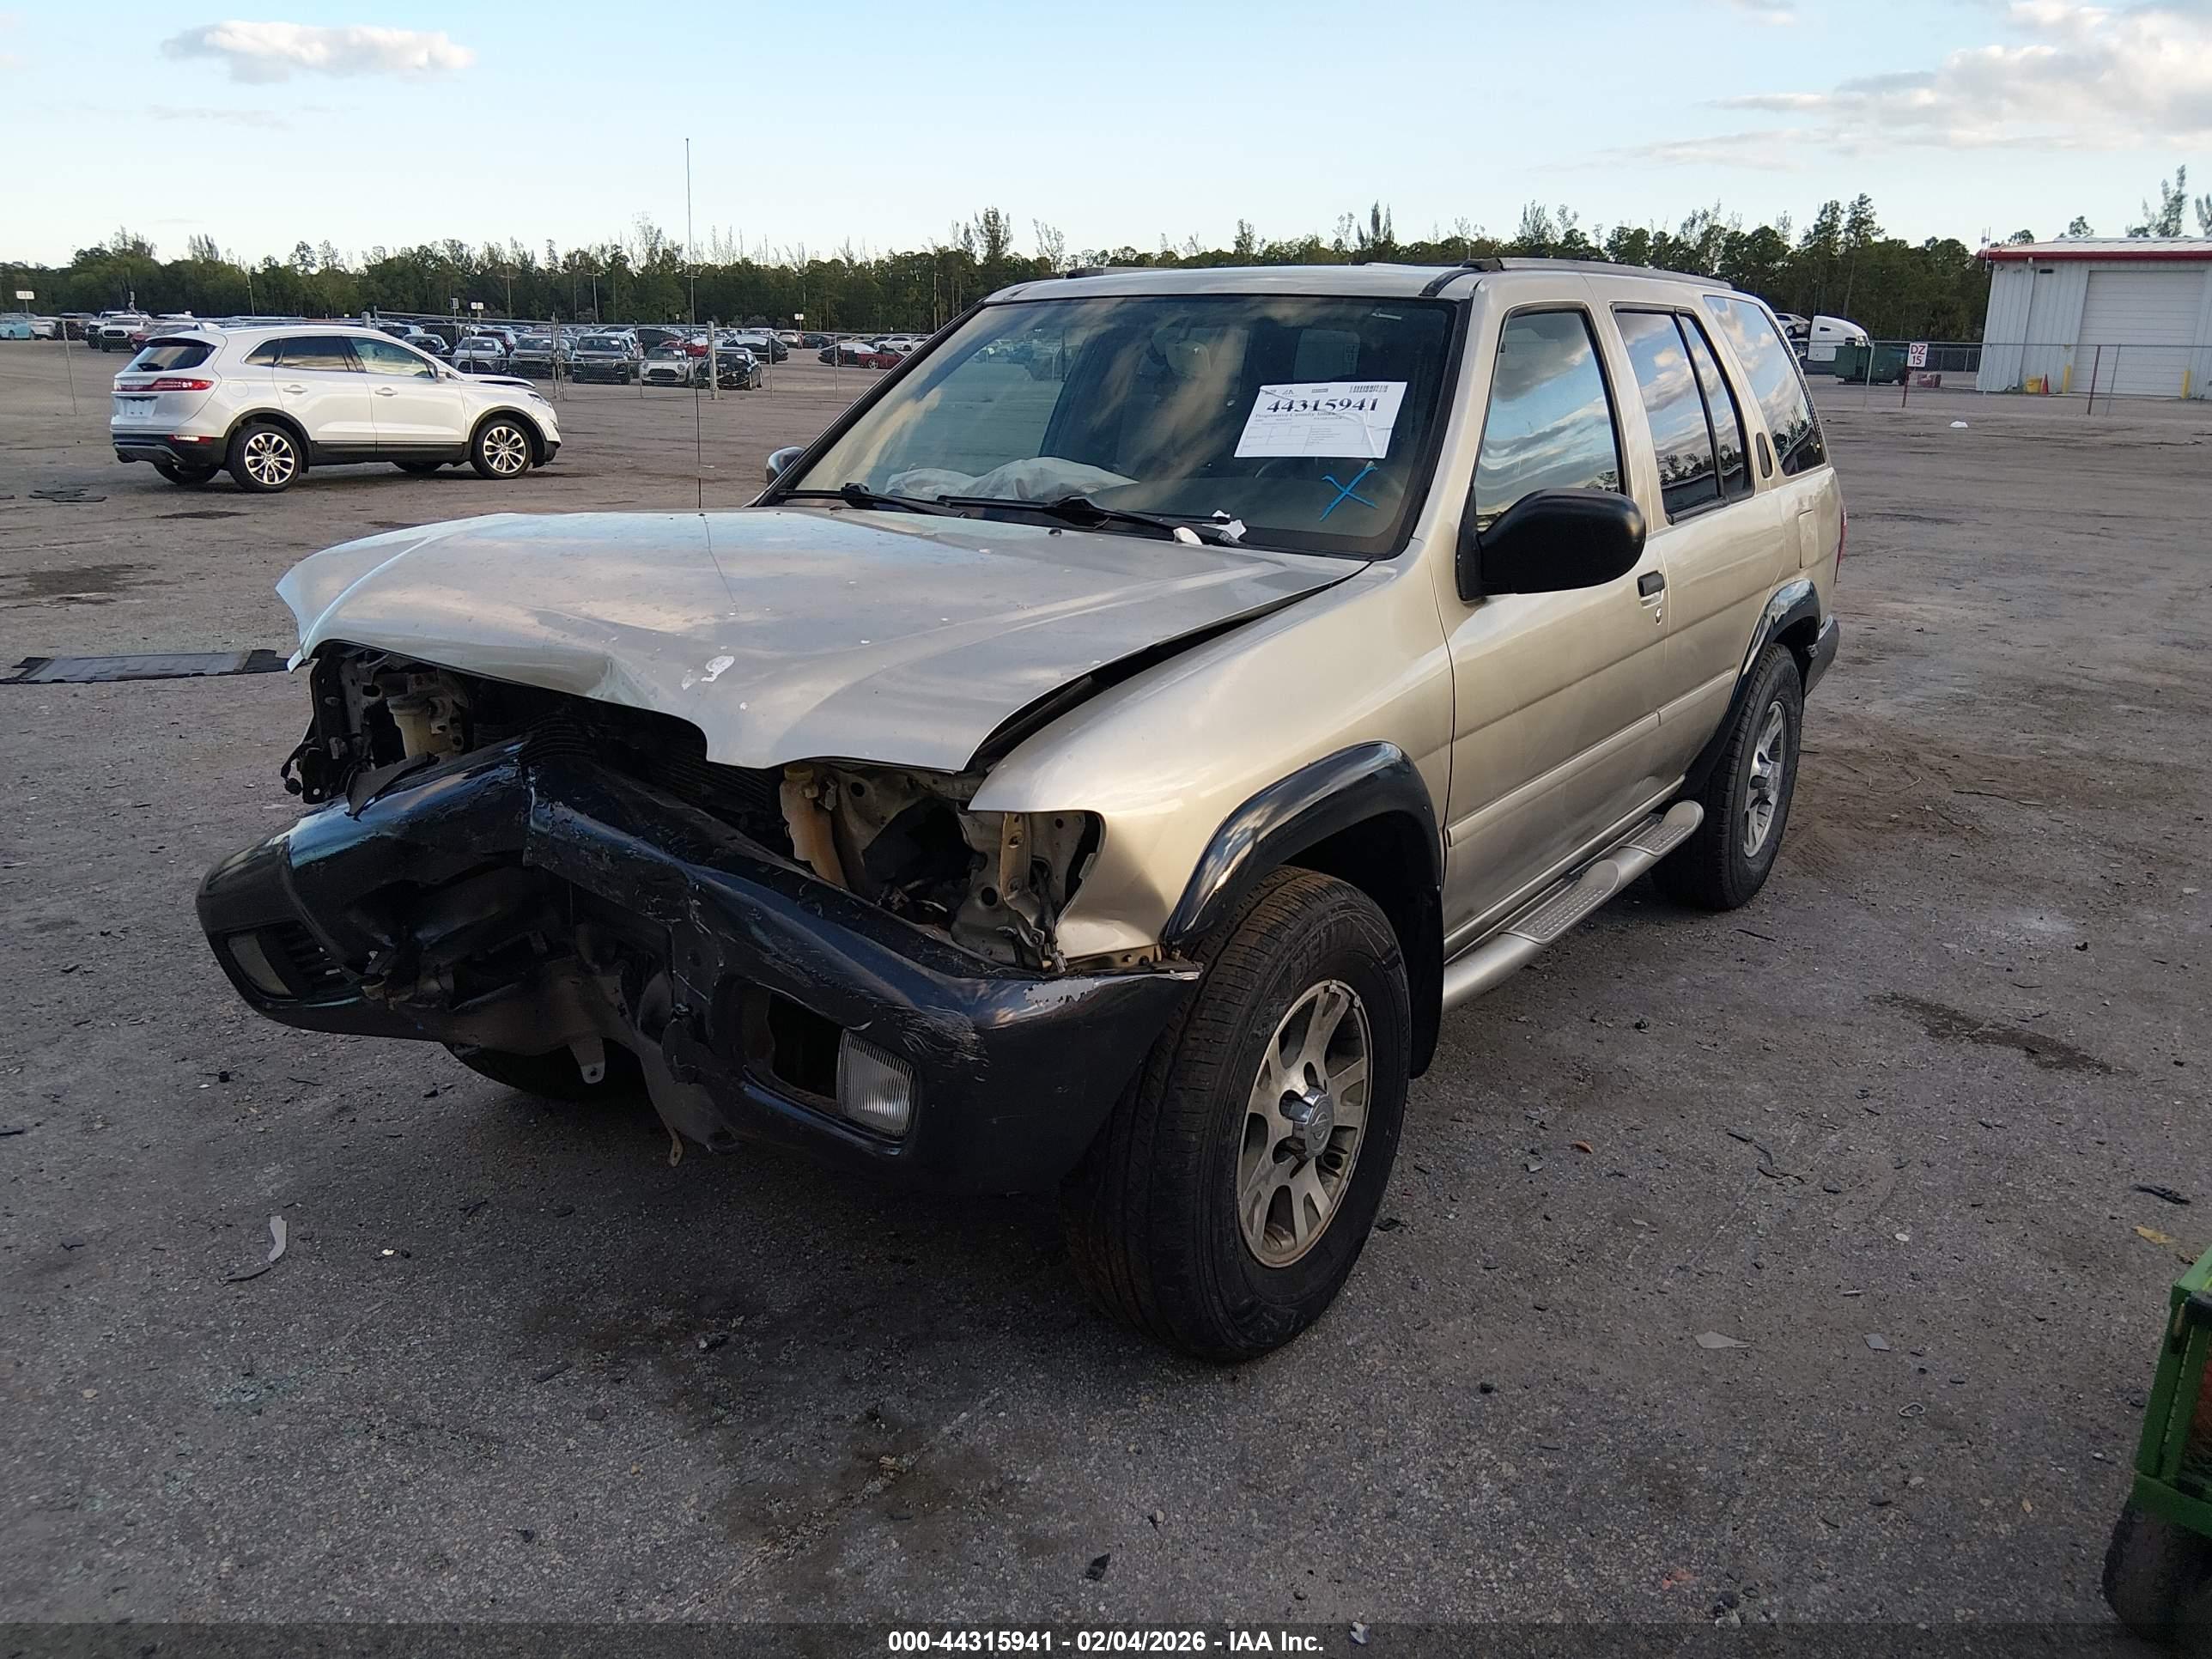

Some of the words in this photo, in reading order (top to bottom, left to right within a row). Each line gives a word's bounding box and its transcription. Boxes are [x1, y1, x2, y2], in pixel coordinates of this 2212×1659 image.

[1911, 344, 1926, 355] DZ
[1912, 356, 1922, 365] 15
[1267, 398, 1378, 412] 44315941
